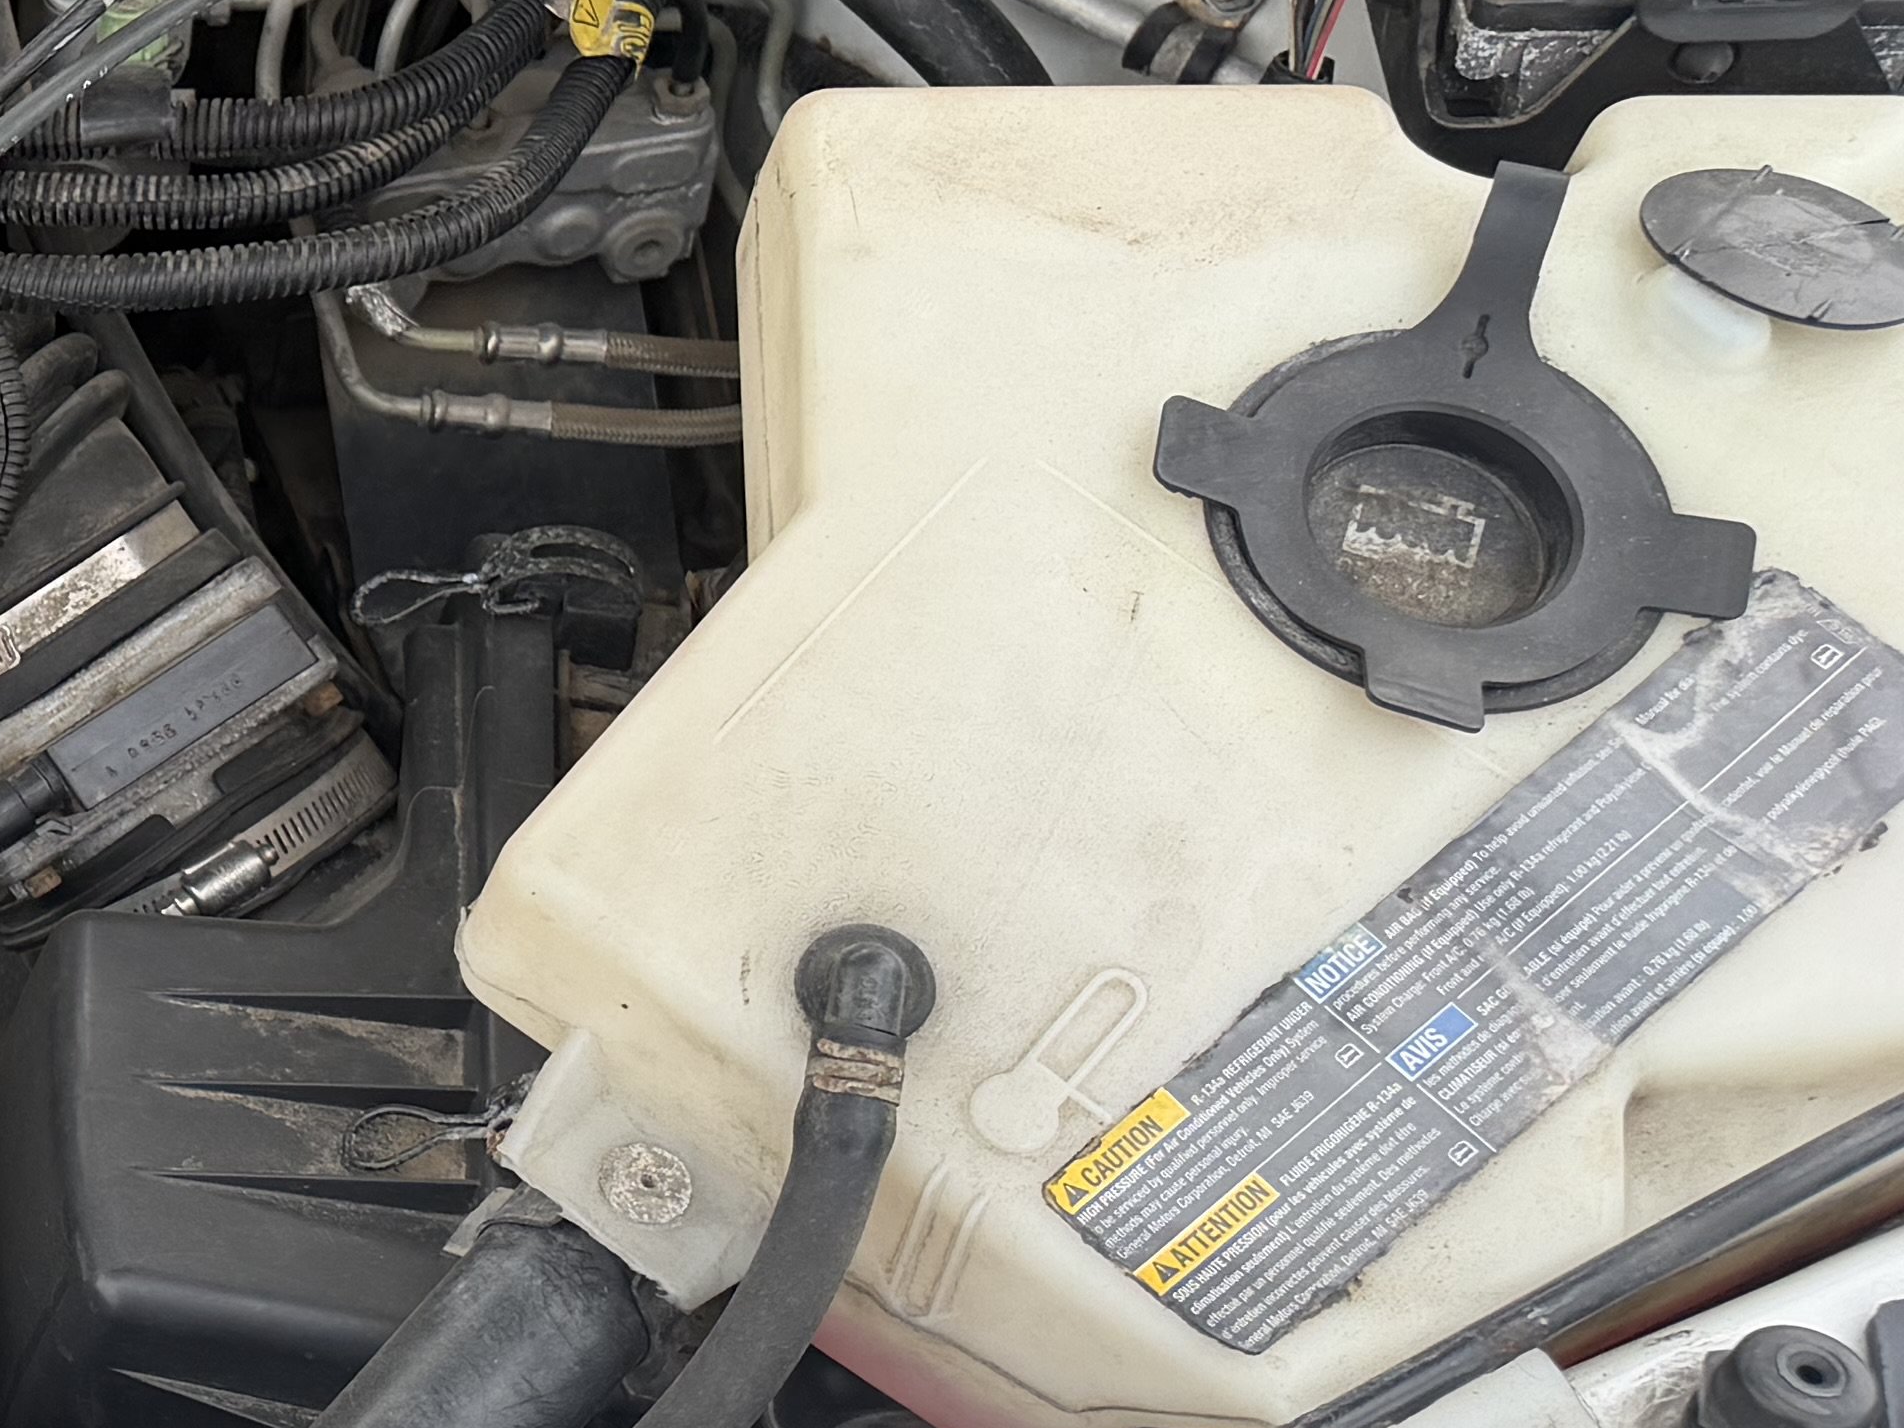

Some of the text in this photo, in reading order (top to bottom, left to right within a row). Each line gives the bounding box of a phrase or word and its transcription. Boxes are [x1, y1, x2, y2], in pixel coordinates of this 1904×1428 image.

[1329, 862, 1502, 1011] procedures before performing any service.
[1344, 850, 1546, 1022] AIR CONDITIONING Equipped) Use only R-134a
[1383, 813, 1530, 939] AIR Equipped) To help avoid
[1435, 854, 1602, 995] Front and 1.00 kg
[1305, 932, 1377, 995] NOTICE
[1360, 915, 1502, 1036] System Front kg
[1190, 1000, 1313, 1105] R-134a REFRIGERANT UNDER
[1396, 1025, 1449, 1071] AVIS
[1075, 1018, 1321, 1225] HIGH PRESSURE (For Air Conditioned Vehicles Only) System
[1078, 1114, 1165, 1188] CAUTION
[1098, 1034, 1327, 1226] be serviced by qualified personnel Improper service
[1102, 1123, 1251, 1247] methods may cause personal injury.
[1145, 1090, 1314, 1232] Motors Detroit, MI SAE J639
[1279, 1080, 1402, 1186] FLUIDE R-134a
[1167, 1179, 1271, 1268] ATTENTION
[1172, 1094, 1416, 1302] SOUS HAUTE PRESSION (pour les avec de
[1187, 1121, 1416, 1315] climatisation seulement) du être
[1238, 1126, 1441, 1302] par un personnel qualifié seulement. Des méthodes
[1261, 1161, 1430, 1305] incorrectes peuvent causer des blessures.
[1265, 1188, 1429, 1327] Motors SAE J639
